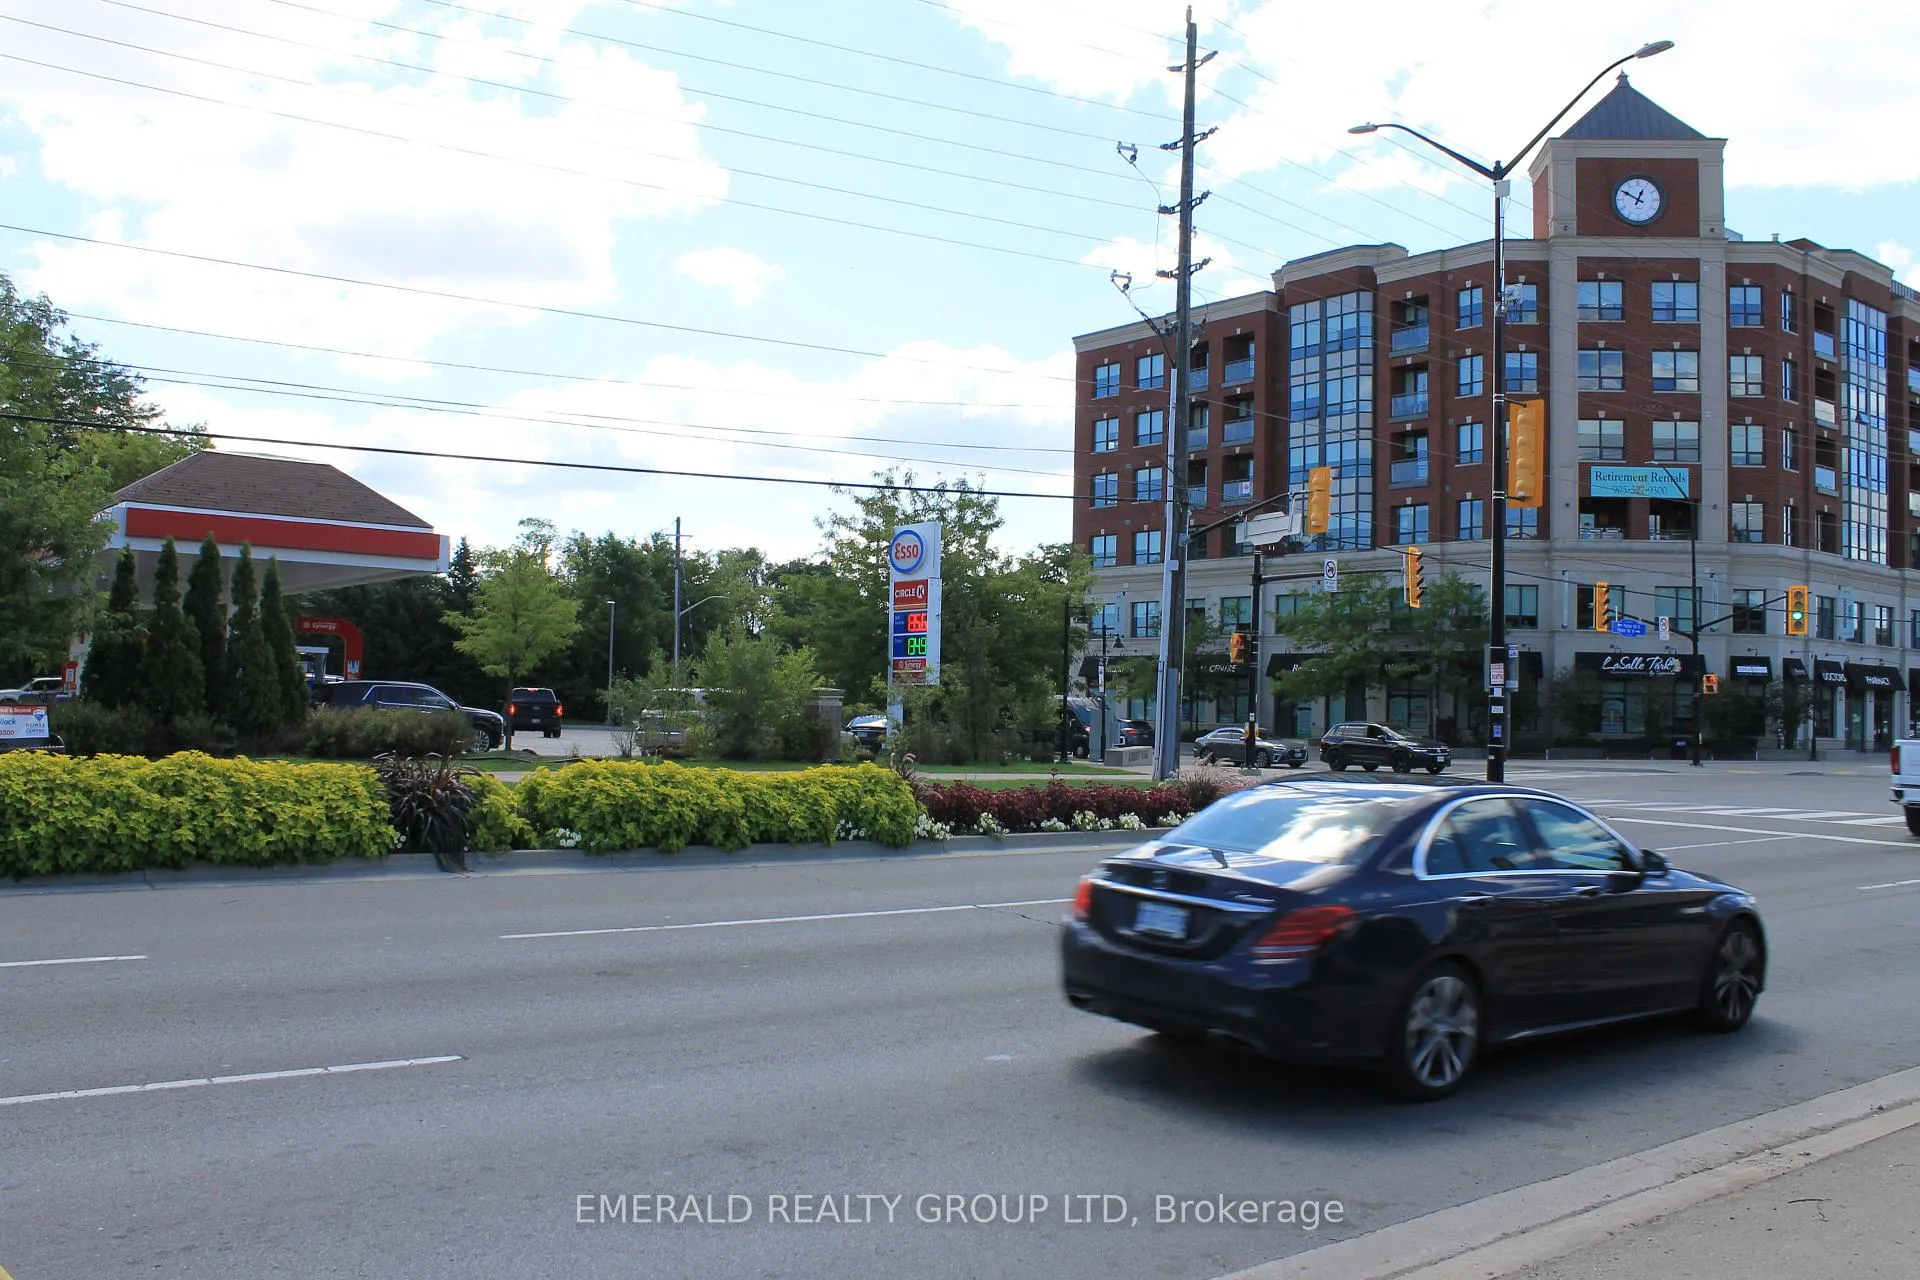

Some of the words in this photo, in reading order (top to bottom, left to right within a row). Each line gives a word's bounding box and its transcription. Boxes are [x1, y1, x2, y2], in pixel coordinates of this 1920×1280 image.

[1594, 471, 1647, 481] Retirement
[895, 588, 916, 598] CIRCLE
[311, 622, 337, 630] Synergy
[1601, 656, 1645, 670] LaSalle
[1646, 656, 1671, 670] Park
